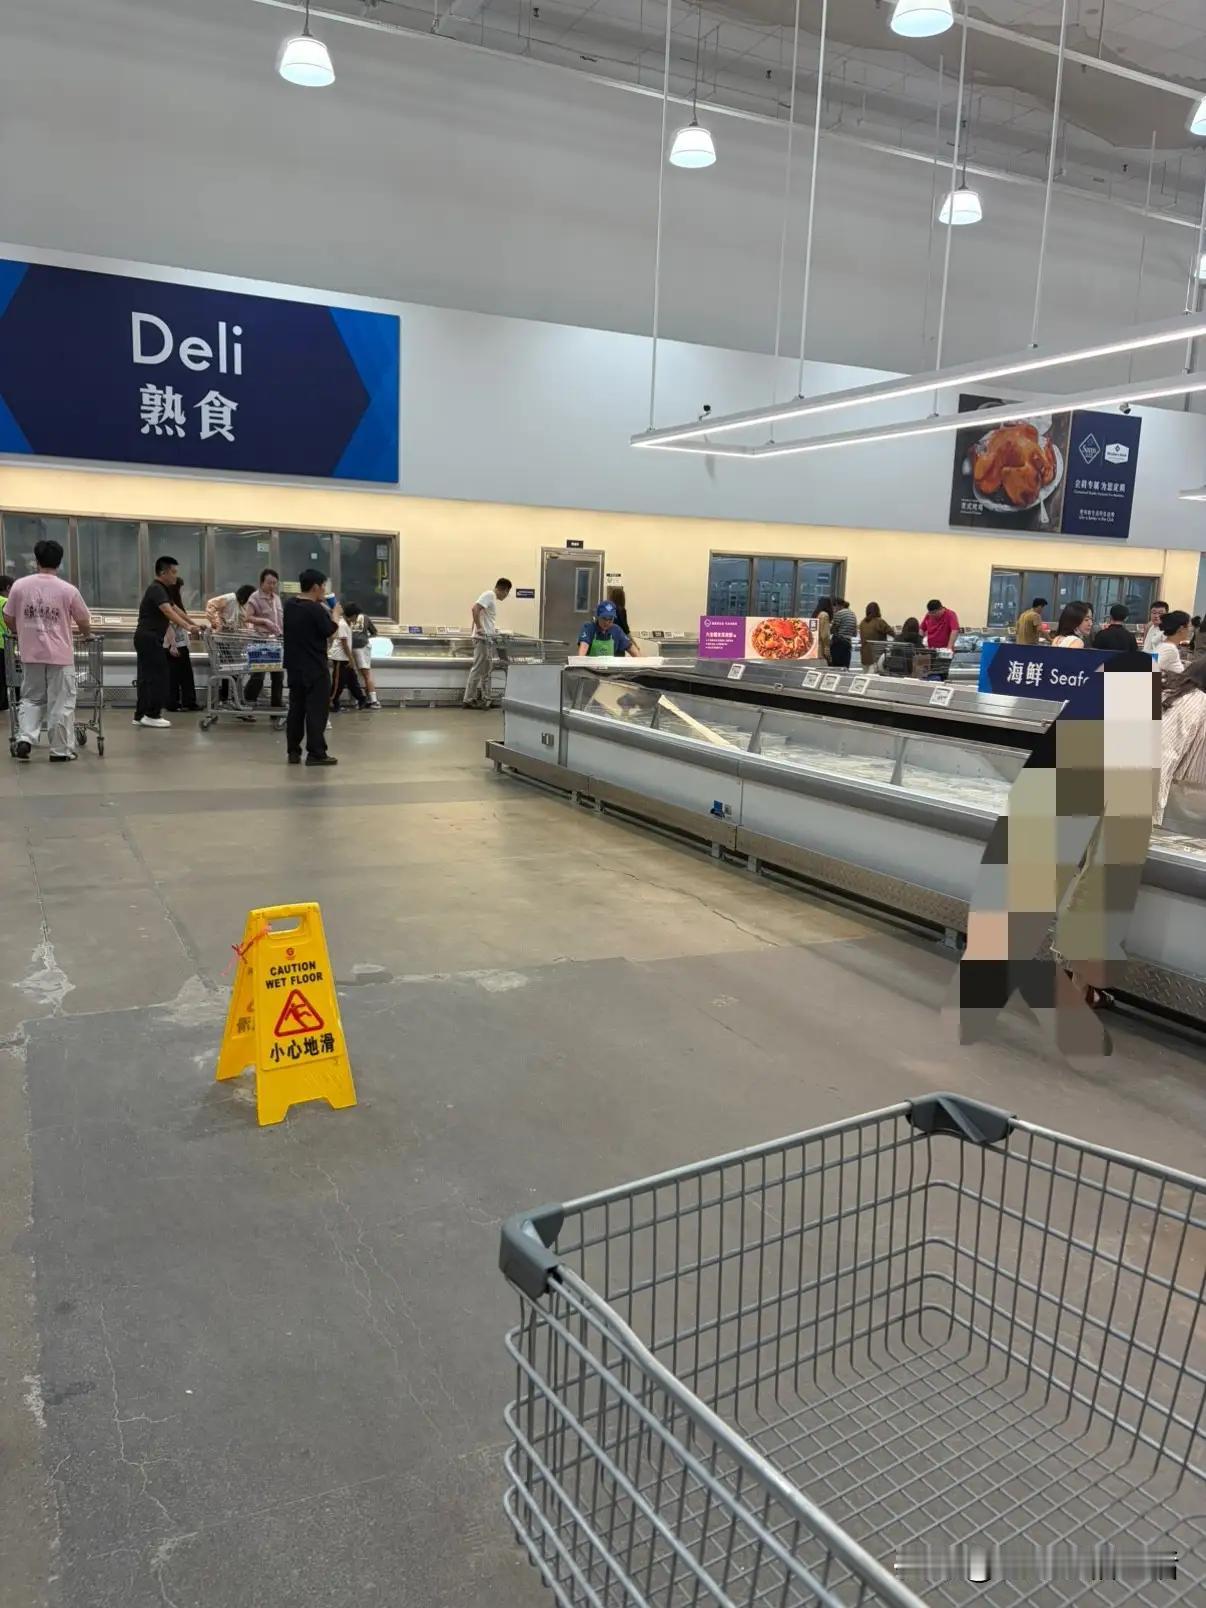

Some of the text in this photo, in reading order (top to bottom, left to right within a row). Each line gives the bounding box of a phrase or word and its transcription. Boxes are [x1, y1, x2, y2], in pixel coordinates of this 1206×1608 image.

[131, 311, 243, 376] Deli
[139, 383, 239, 442] 熟食
[1007, 660, 1044, 687] 海鲜
[265, 972, 323, 989] WET FLOOR
[270, 961, 315, 976] CAUTION
[270, 1033, 335, 1063] 小心地滑
